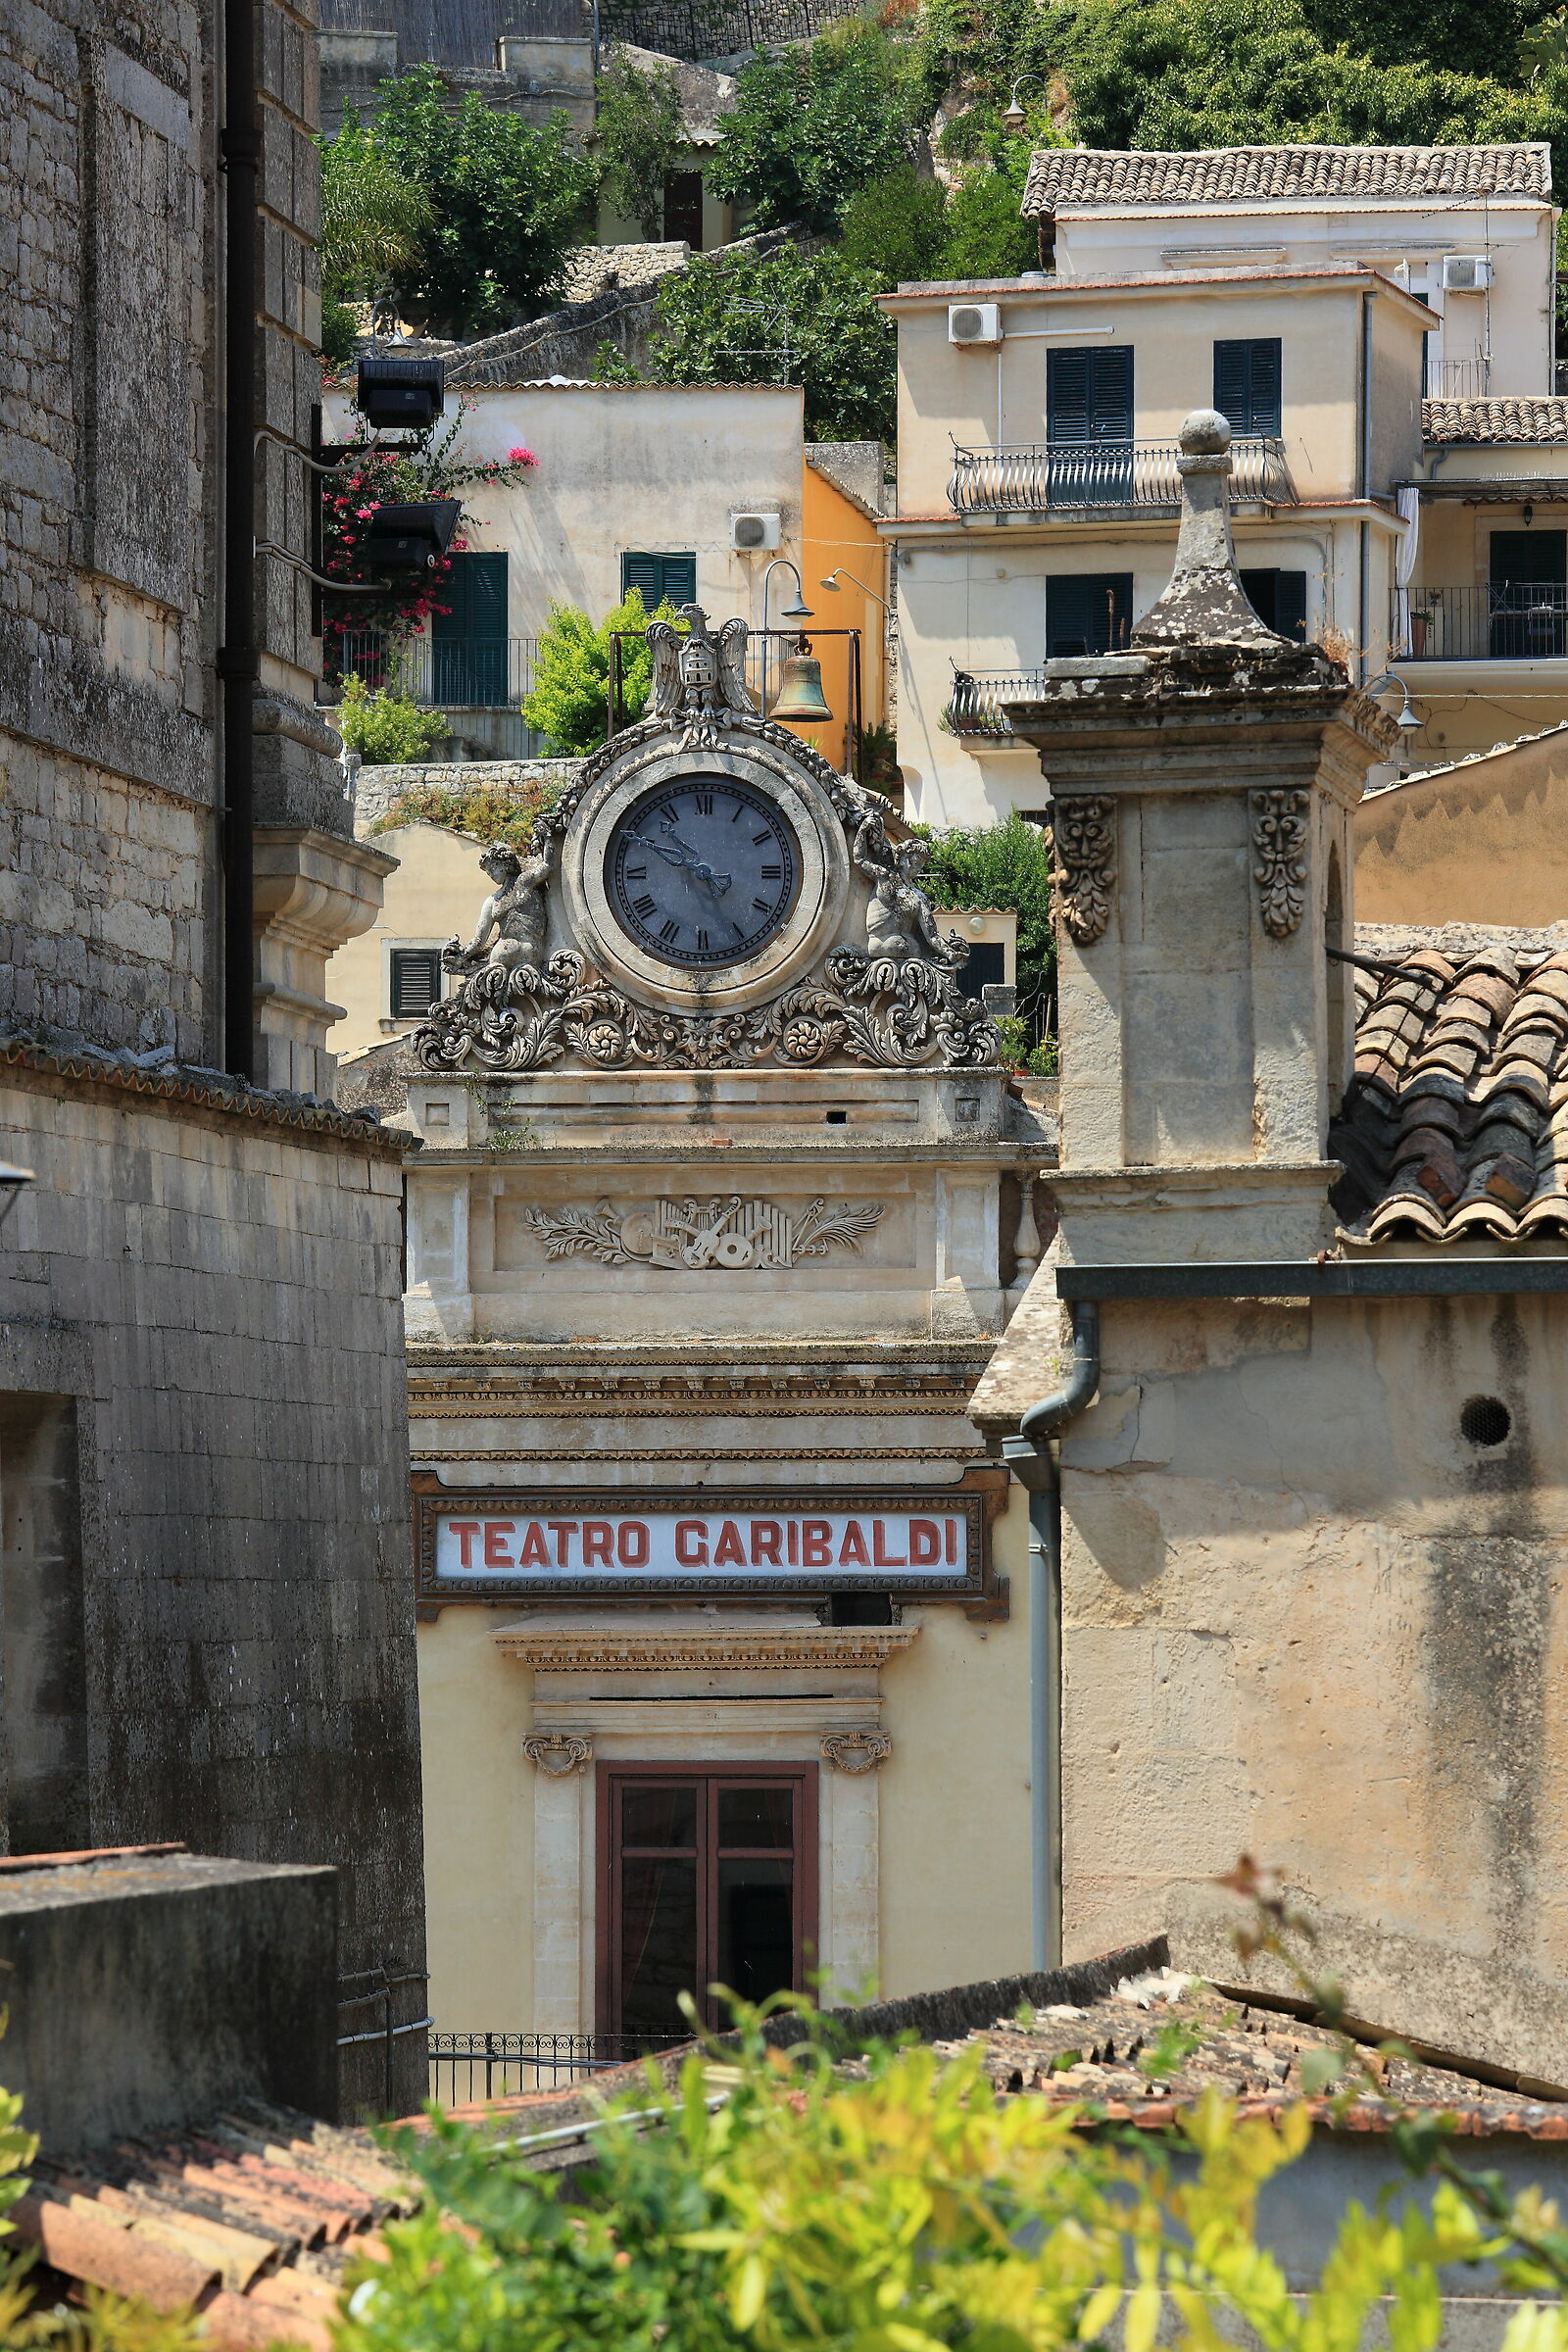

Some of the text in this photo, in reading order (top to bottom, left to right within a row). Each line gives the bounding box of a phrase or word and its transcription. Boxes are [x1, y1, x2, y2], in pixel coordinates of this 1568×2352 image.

[695, 794, 713, 815] XII
[760, 864, 781, 880] III
[448, 1519, 957, 1569] TEATRO GARIBALDI
